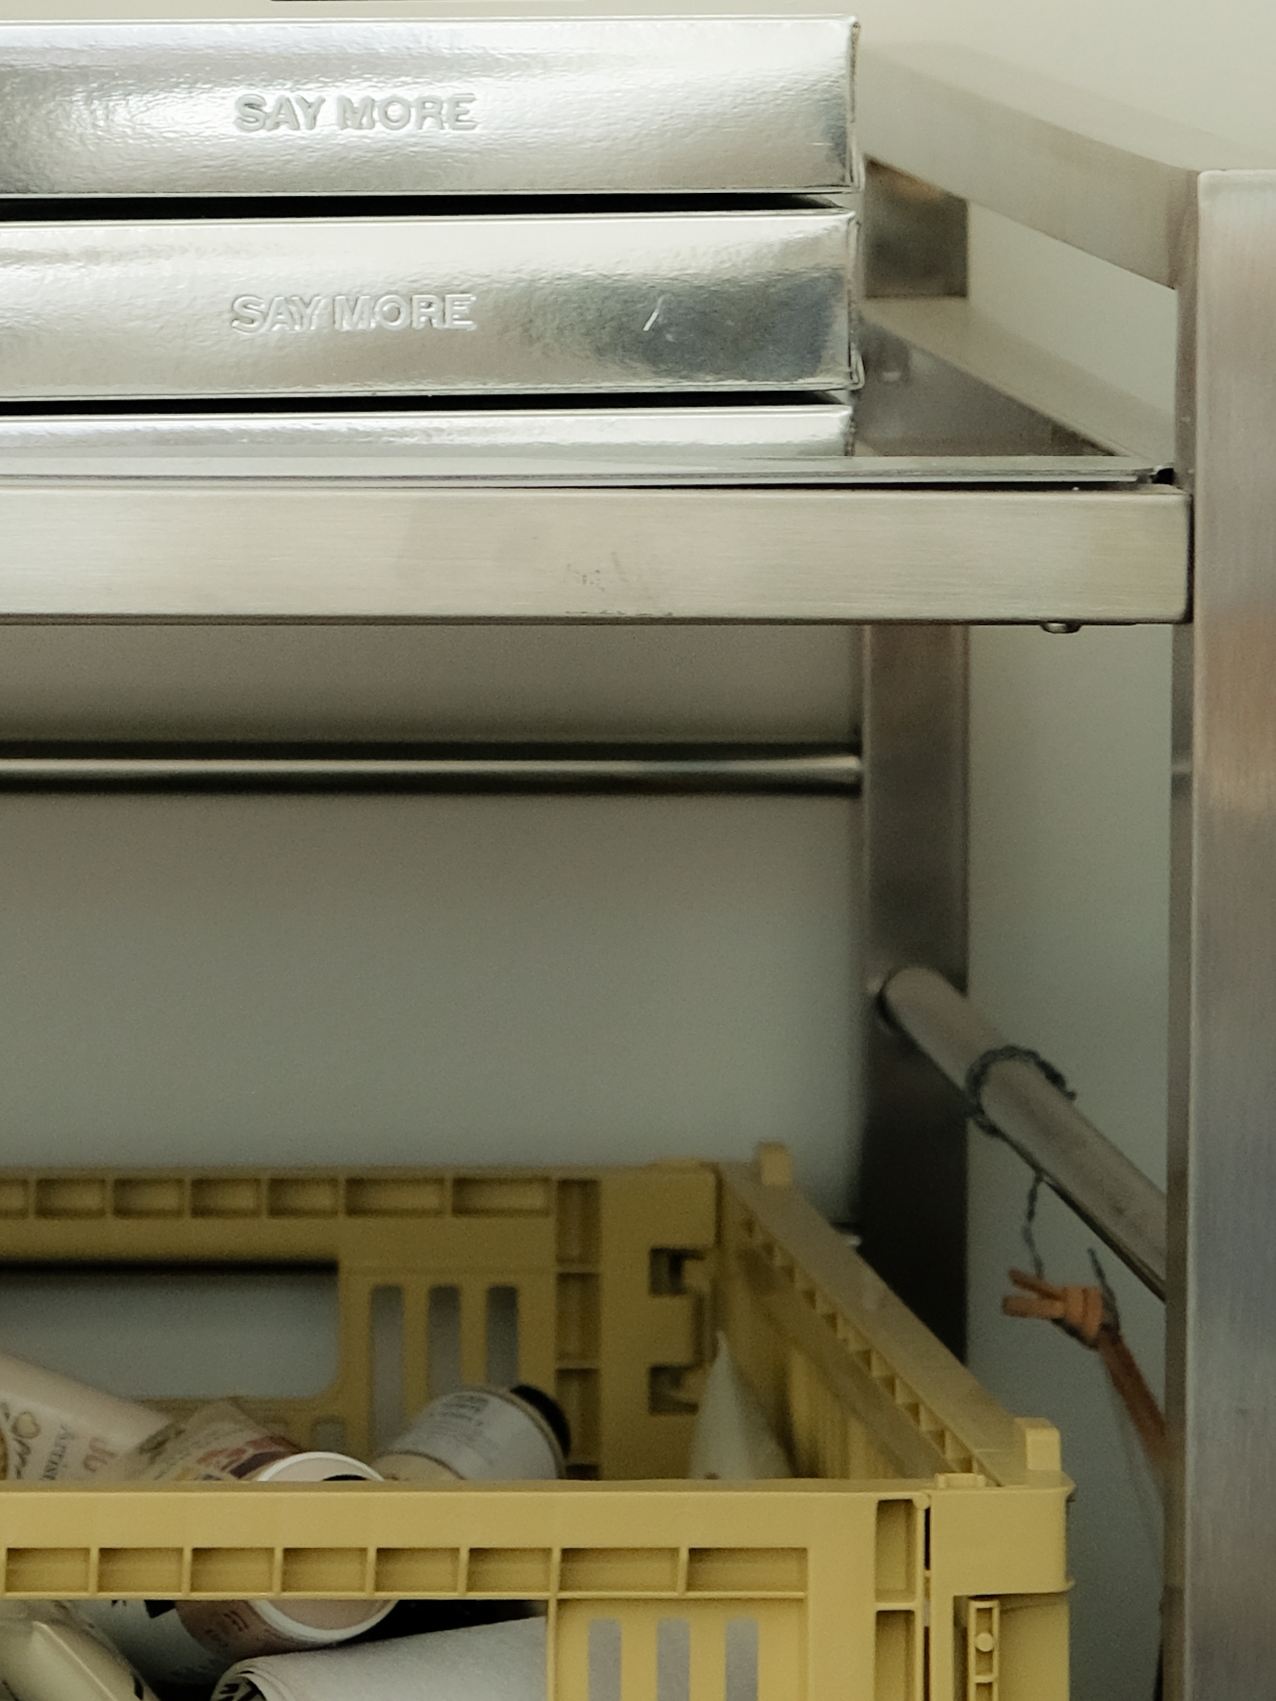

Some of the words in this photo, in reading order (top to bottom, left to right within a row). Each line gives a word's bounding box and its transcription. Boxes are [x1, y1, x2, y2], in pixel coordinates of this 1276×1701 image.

[232, 93, 326, 132] SAY
[336, 92, 480, 131] MORE
[231, 294, 324, 336] SAY
[333, 293, 478, 331] MORE
